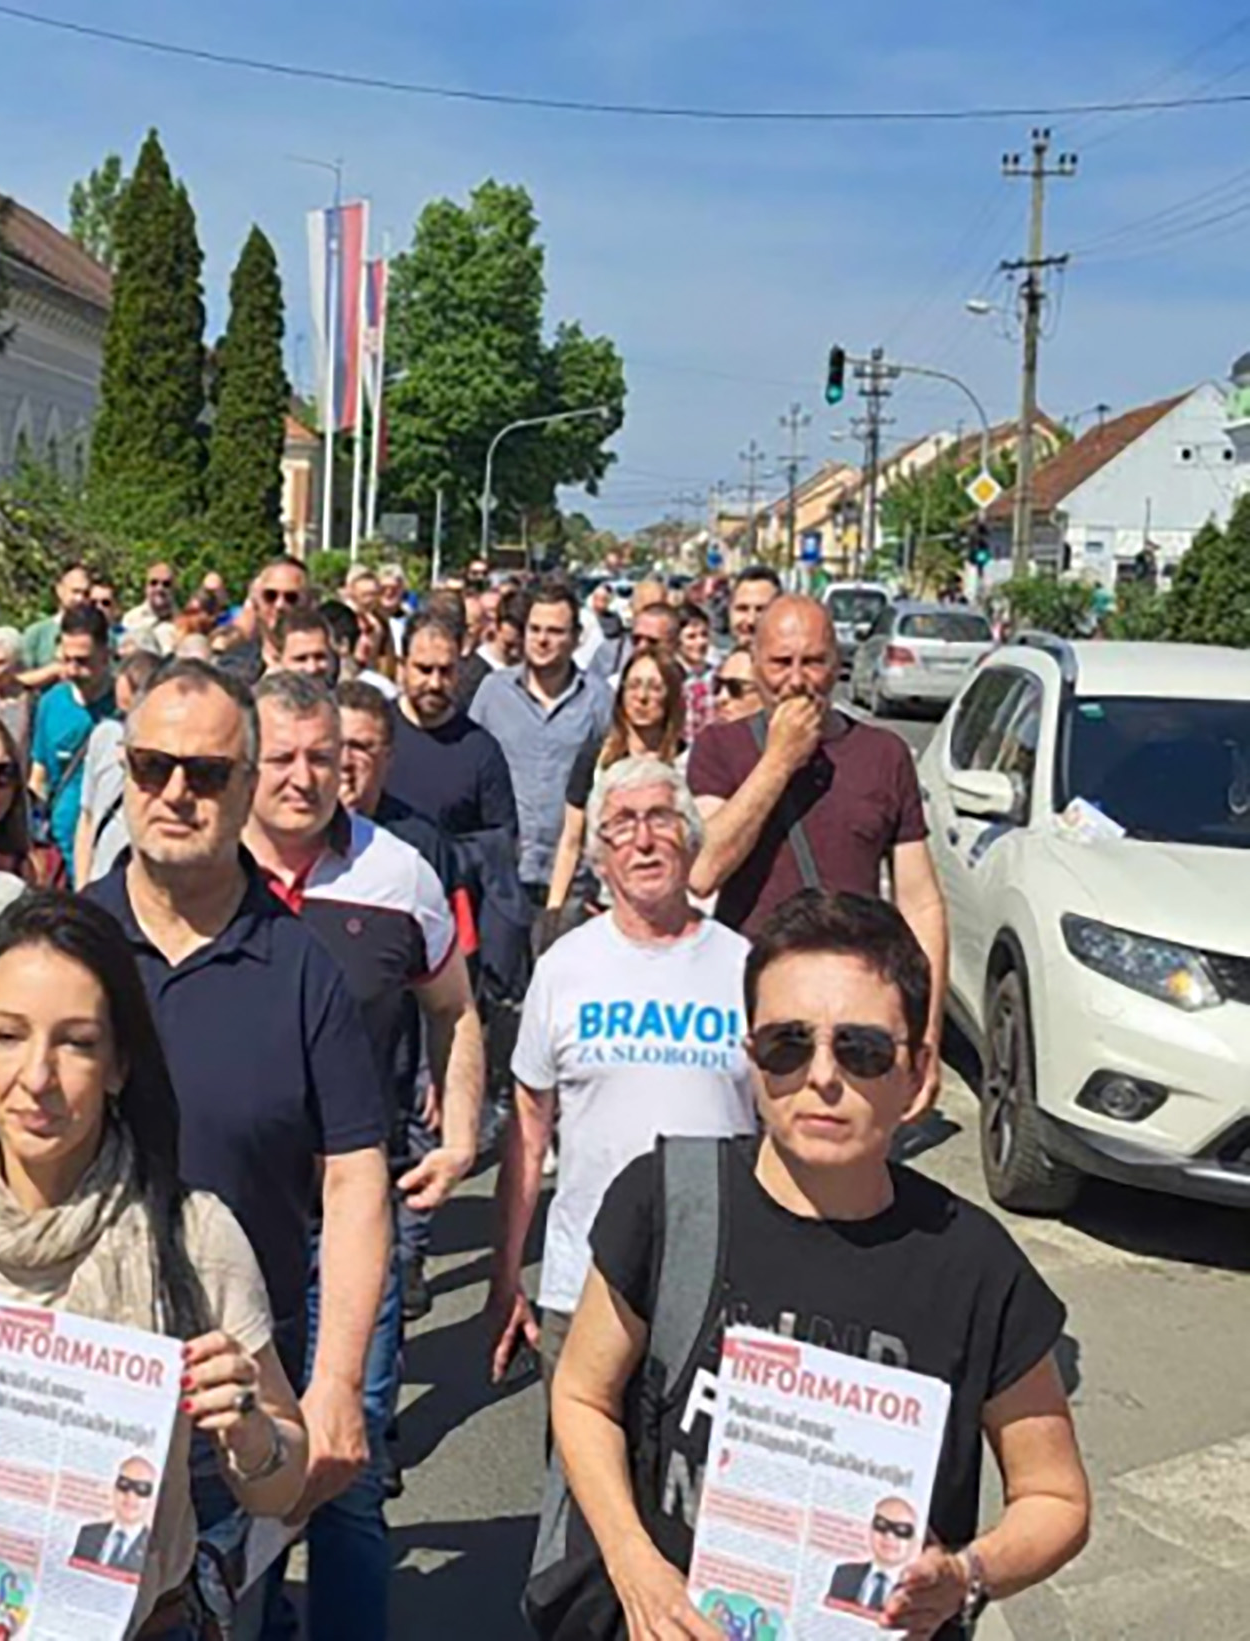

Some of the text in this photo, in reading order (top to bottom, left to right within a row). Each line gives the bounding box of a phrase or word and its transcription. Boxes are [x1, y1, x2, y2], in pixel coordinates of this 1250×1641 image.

[579, 1000, 738, 1048] BRAVO!
[577, 1045, 735, 1069] ZA SLOBODU
[730, 1352, 923, 1427] INFORMATOR
